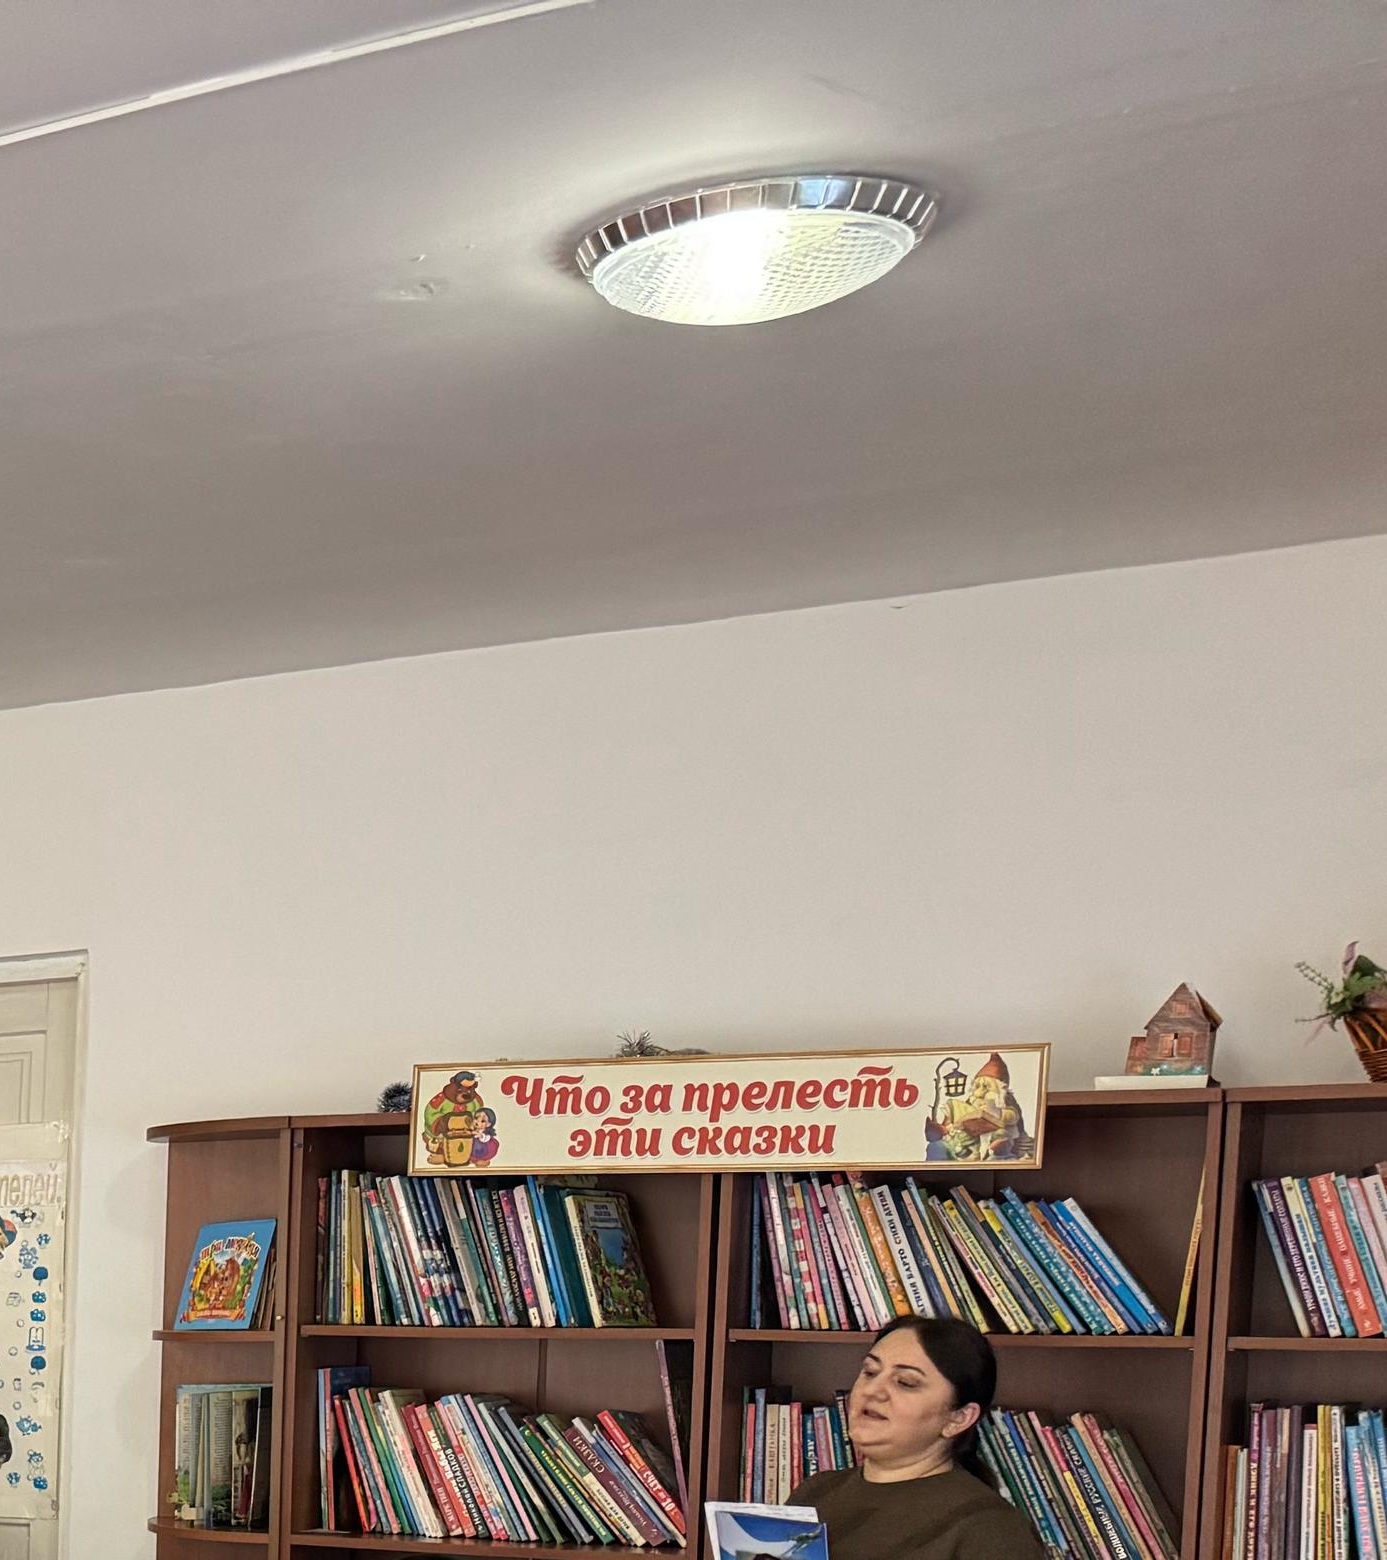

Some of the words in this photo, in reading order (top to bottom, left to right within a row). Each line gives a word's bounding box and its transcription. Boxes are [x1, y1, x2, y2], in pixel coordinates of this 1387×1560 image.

[500, 1073, 612, 1118] Что
[621, 1079, 666, 1115] за
[674, 1065, 920, 1124] прелесть
[567, 1117, 663, 1159] эти
[670, 1121, 838, 1157] сказки
[889, 1218, 902, 1246] СТИХИ
[898, 1248, 914, 1280] БАРТО
[909, 1282, 927, 1314] АГНИЯ
[571, 1435, 605, 1473] СКАЗКИ
